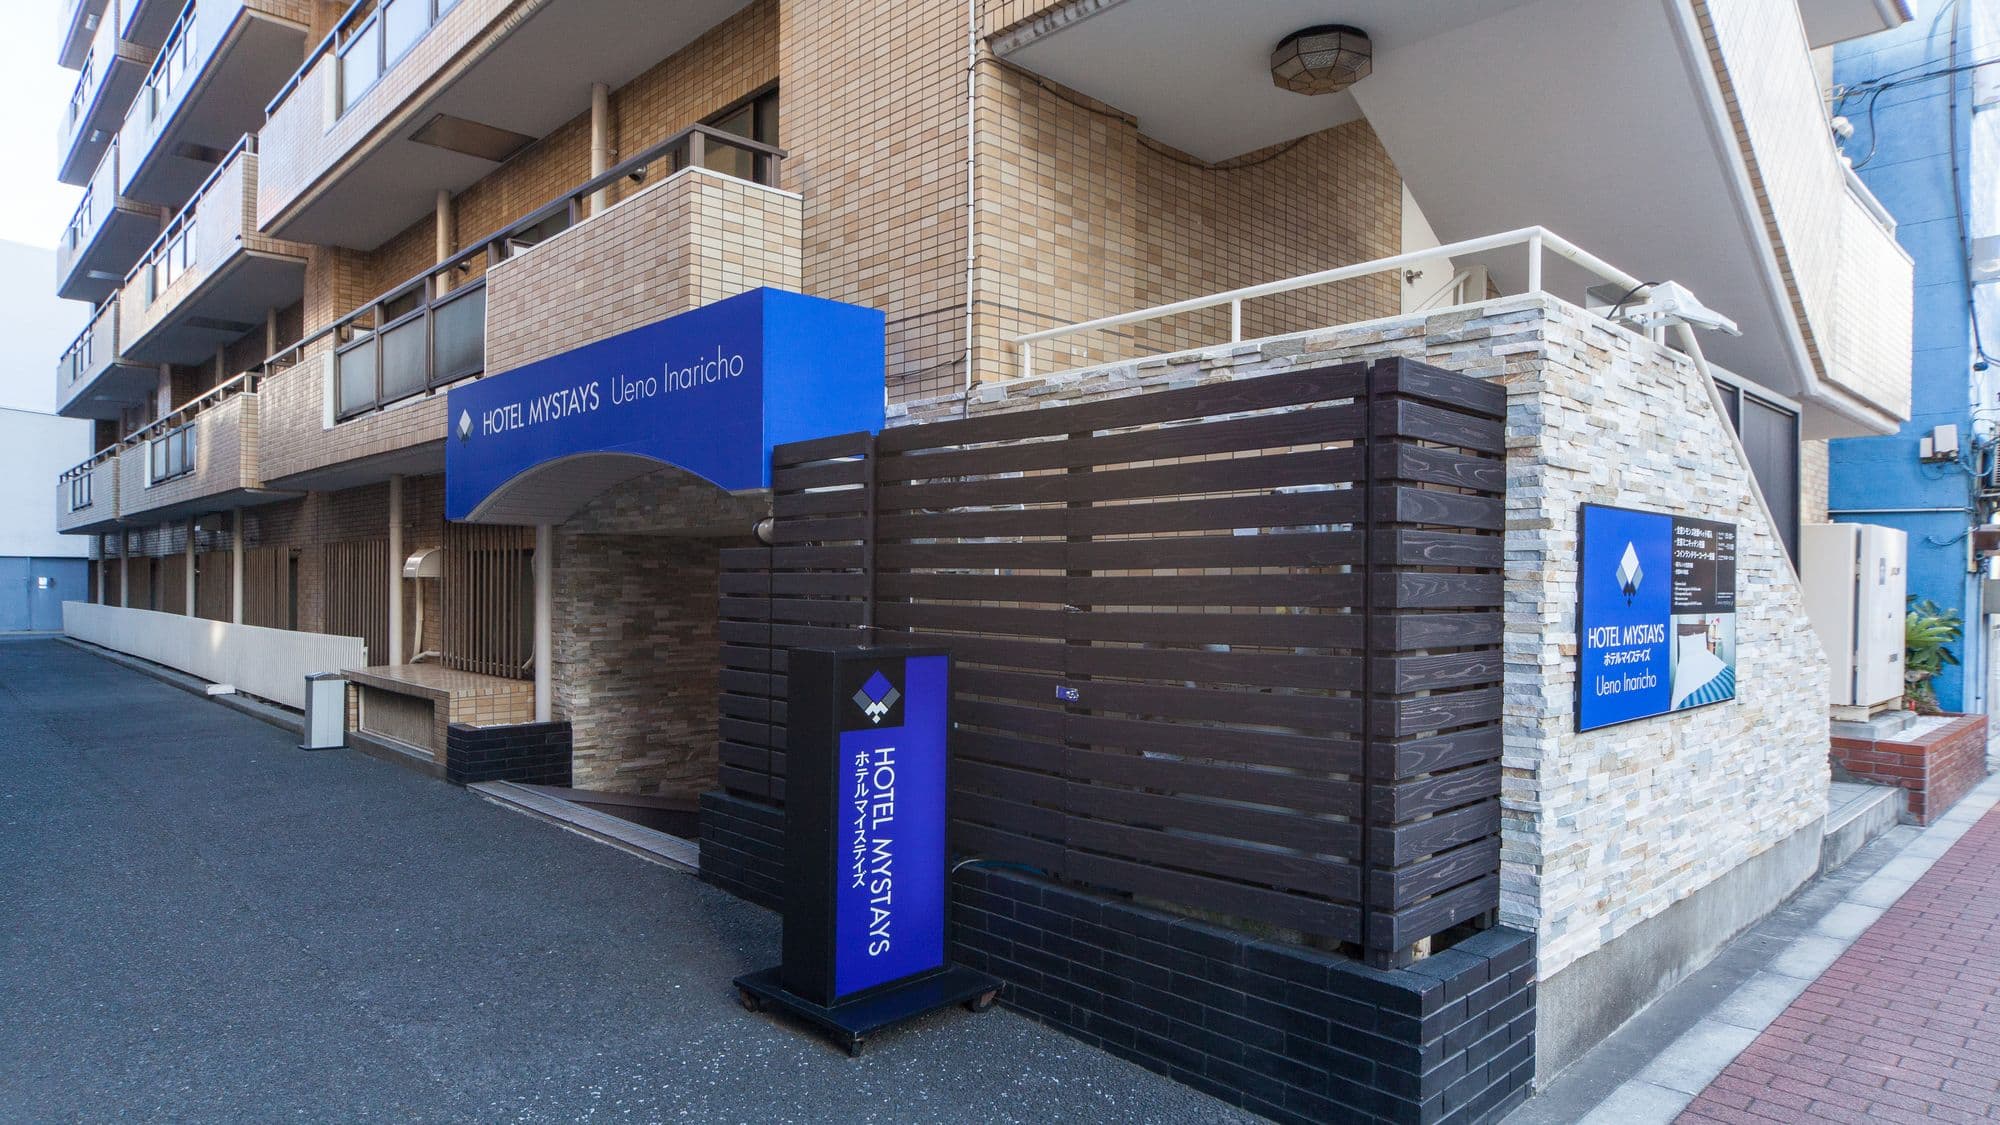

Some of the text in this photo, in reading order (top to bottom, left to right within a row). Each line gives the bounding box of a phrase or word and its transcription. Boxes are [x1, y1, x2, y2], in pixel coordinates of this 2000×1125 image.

[483, 345, 744, 436] HOTEL MYSTAYS Ueno Inaricho
[1588, 623, 1664, 648] HOTEL MYSTAYS
[1603, 648, 1651, 666] ホテルマイステイズ
[1596, 667, 1656, 696] Ueno Inaricho
[852, 751, 870, 889] ホテルマイステイズ
[868, 747, 895, 956] HOTEL MYSTAYS
